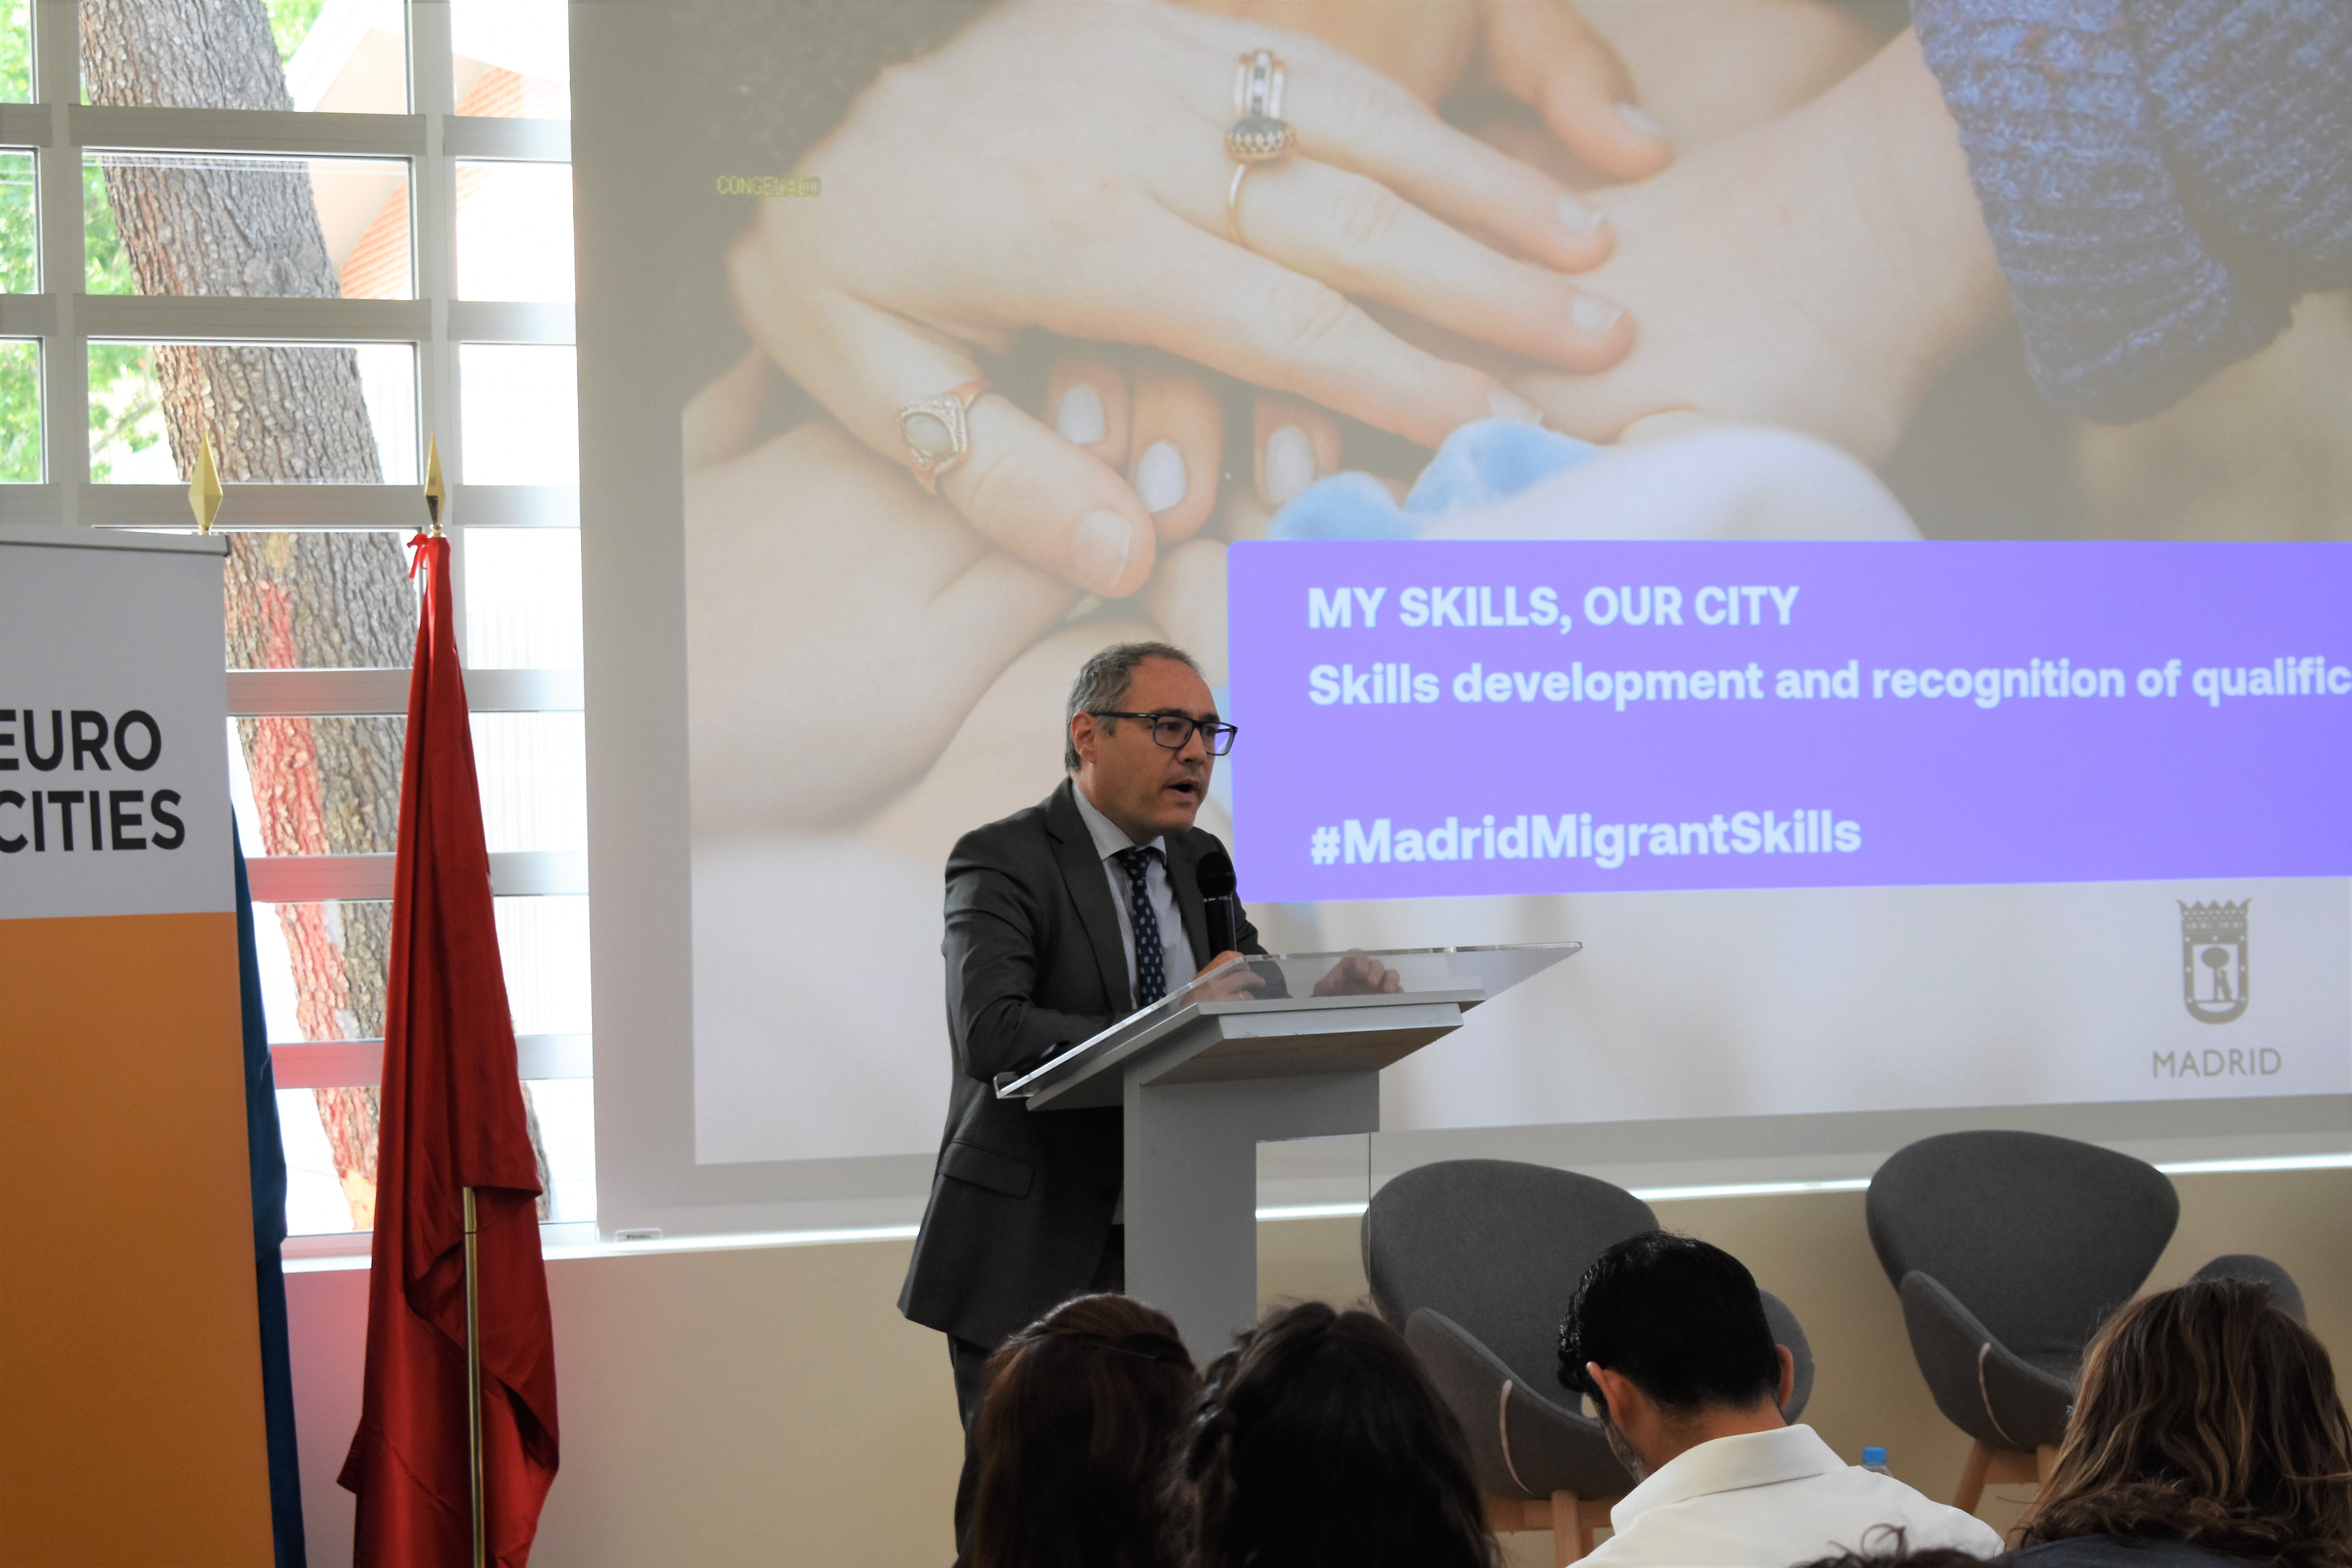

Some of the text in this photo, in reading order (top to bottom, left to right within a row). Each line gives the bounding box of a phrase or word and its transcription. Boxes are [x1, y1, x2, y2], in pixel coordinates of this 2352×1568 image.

[717, 175, 822, 197] CONGELADO
[1309, 585, 1799, 634] MY SKILLS, OUR CITY
[1309, 656, 2352, 711] Skills development and recognition of qualific
[0, 789, 185, 853] CITIES
[1311, 808, 1861, 868] #MadridMigrantSkills
[2152, 1047, 2283, 1079] MADRID
